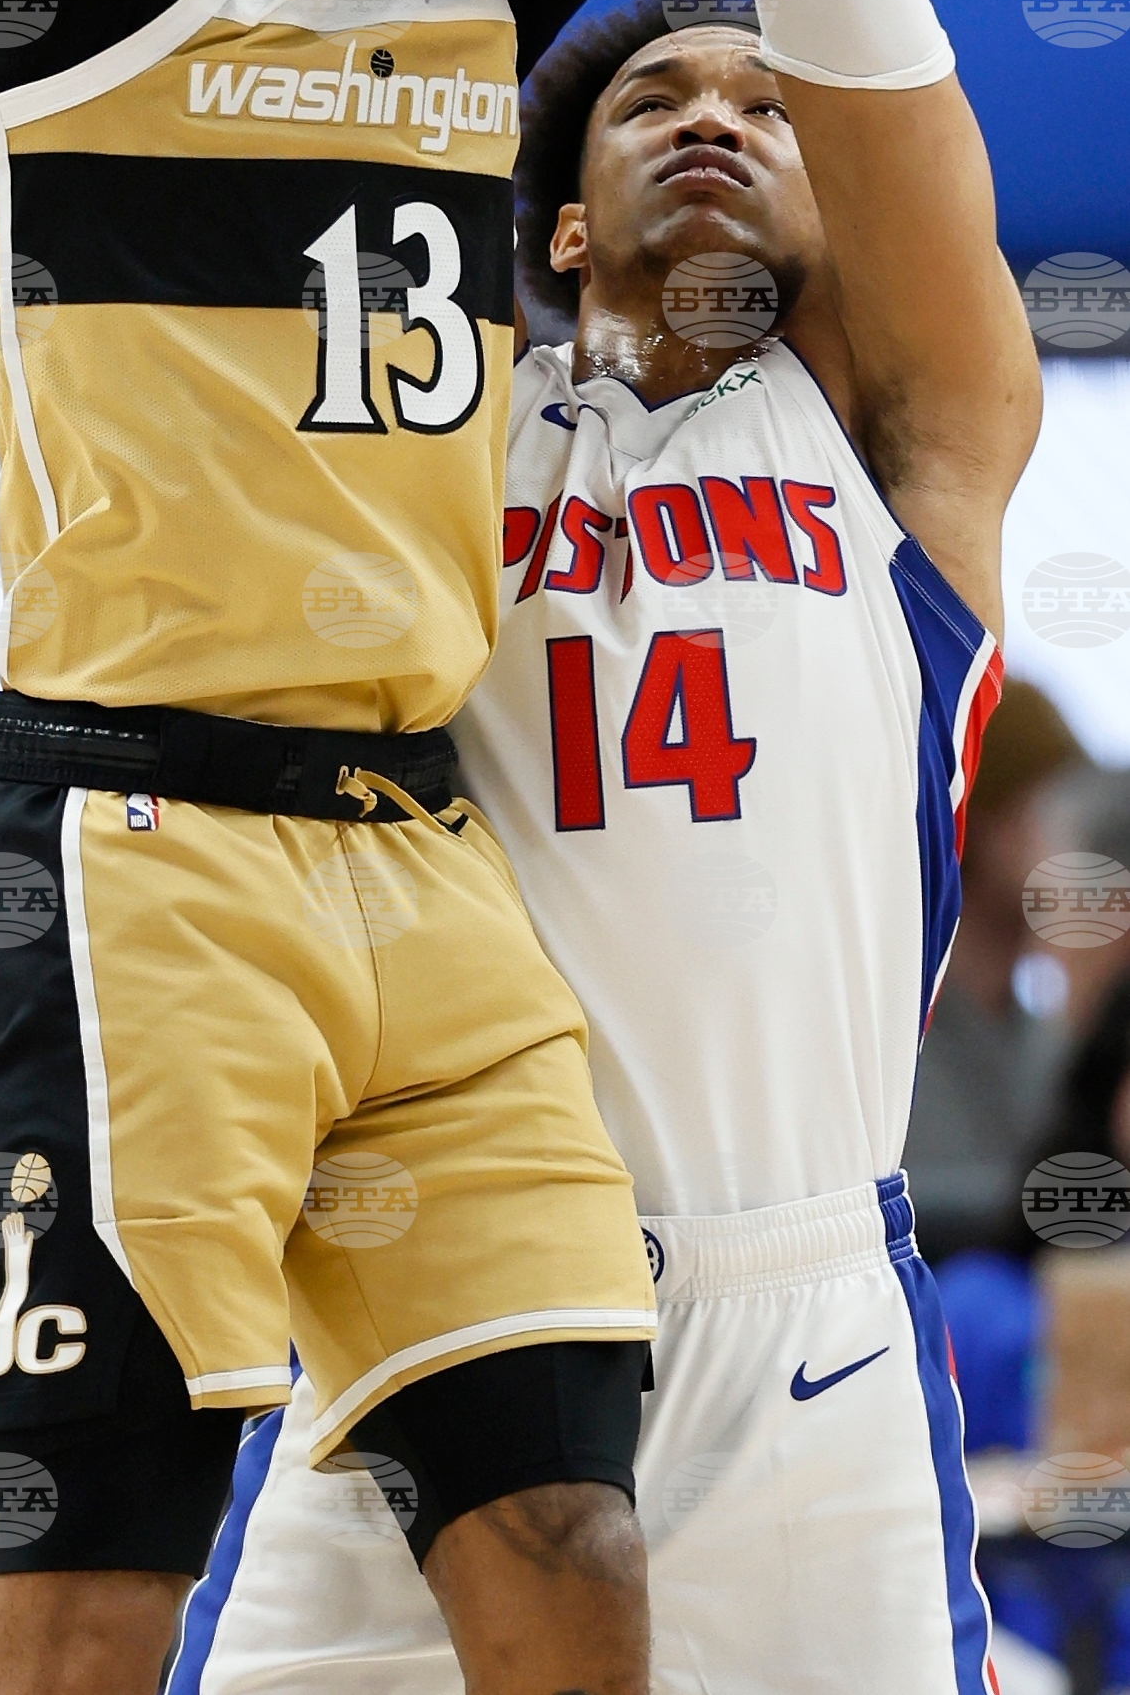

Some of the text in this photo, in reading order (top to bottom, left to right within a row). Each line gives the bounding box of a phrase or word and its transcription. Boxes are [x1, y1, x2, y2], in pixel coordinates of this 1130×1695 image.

[296, 199, 485, 435] 13
[130, 814, 149, 828] NBA
[546, 628, 757, 832] 14
